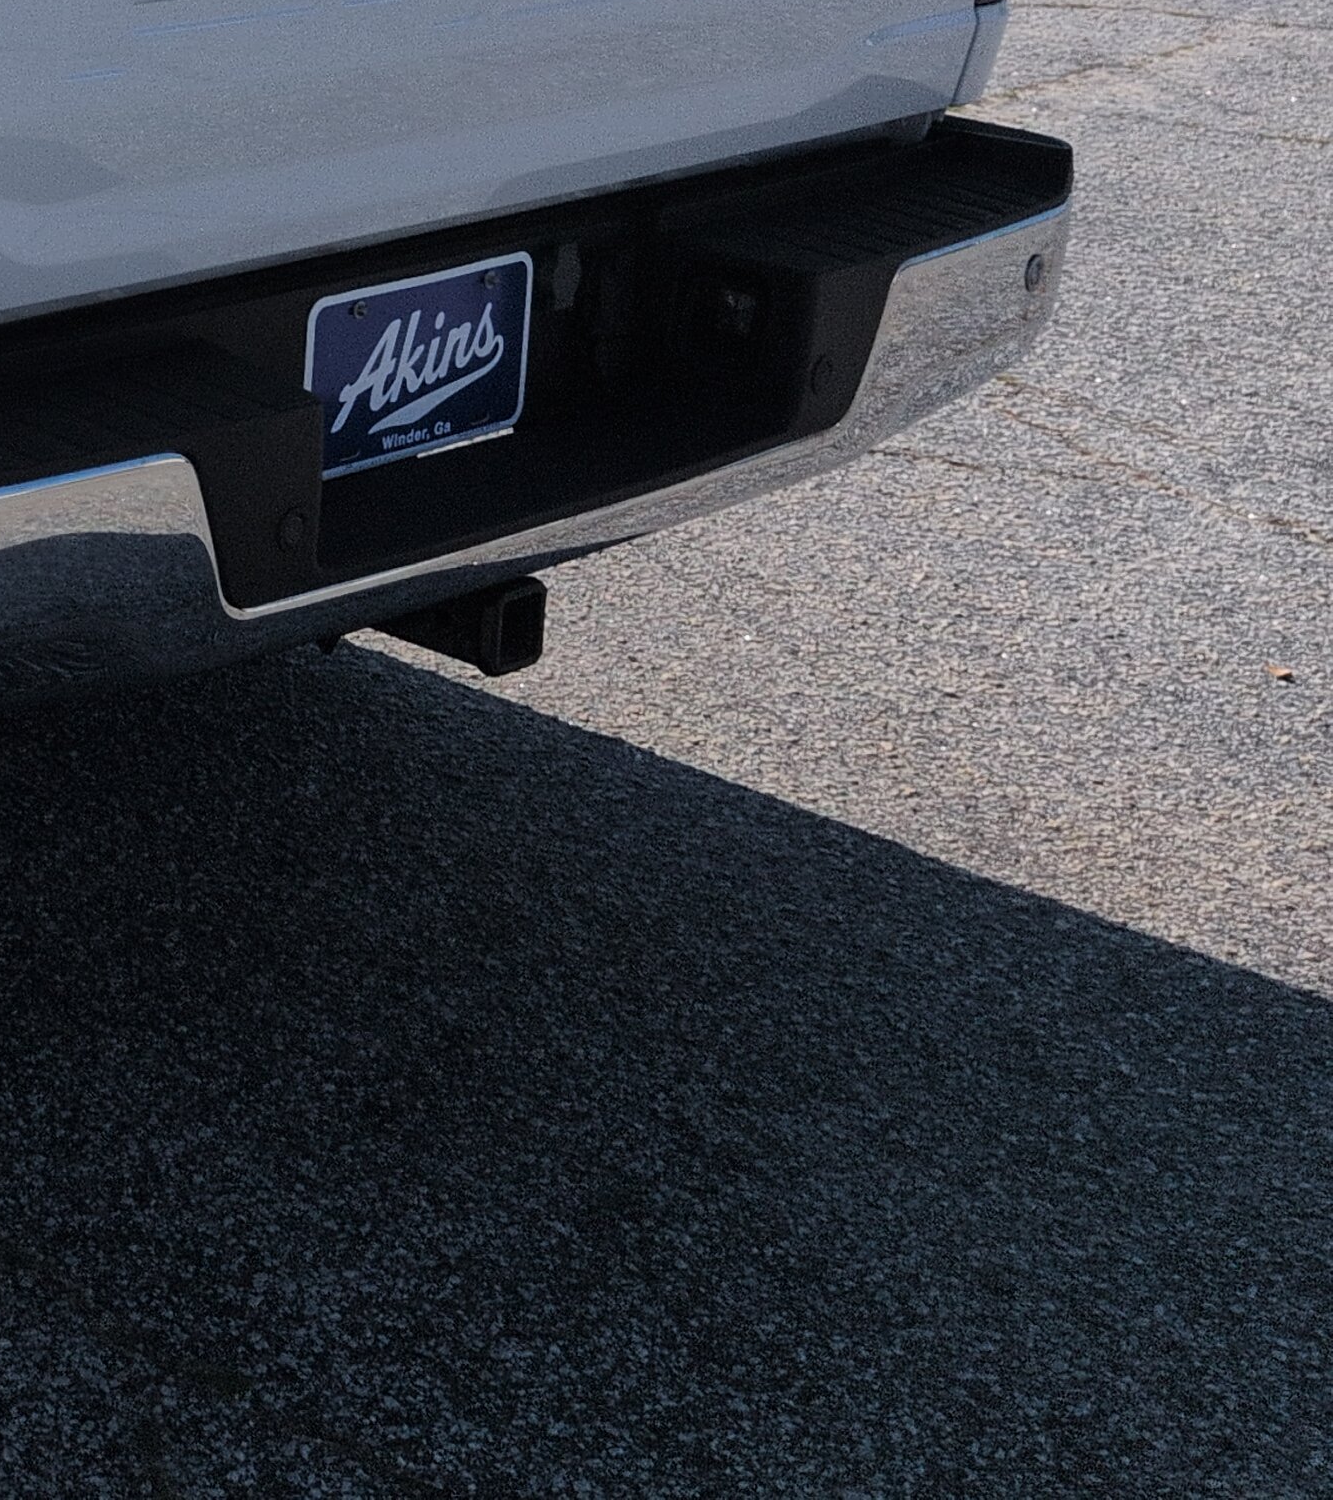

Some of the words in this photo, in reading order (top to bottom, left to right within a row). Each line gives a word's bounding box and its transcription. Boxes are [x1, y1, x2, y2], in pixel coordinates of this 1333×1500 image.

[331, 302, 504, 434] Akins
[382, 428, 430, 450] Winder,
[434, 420, 451, 435] Ga
